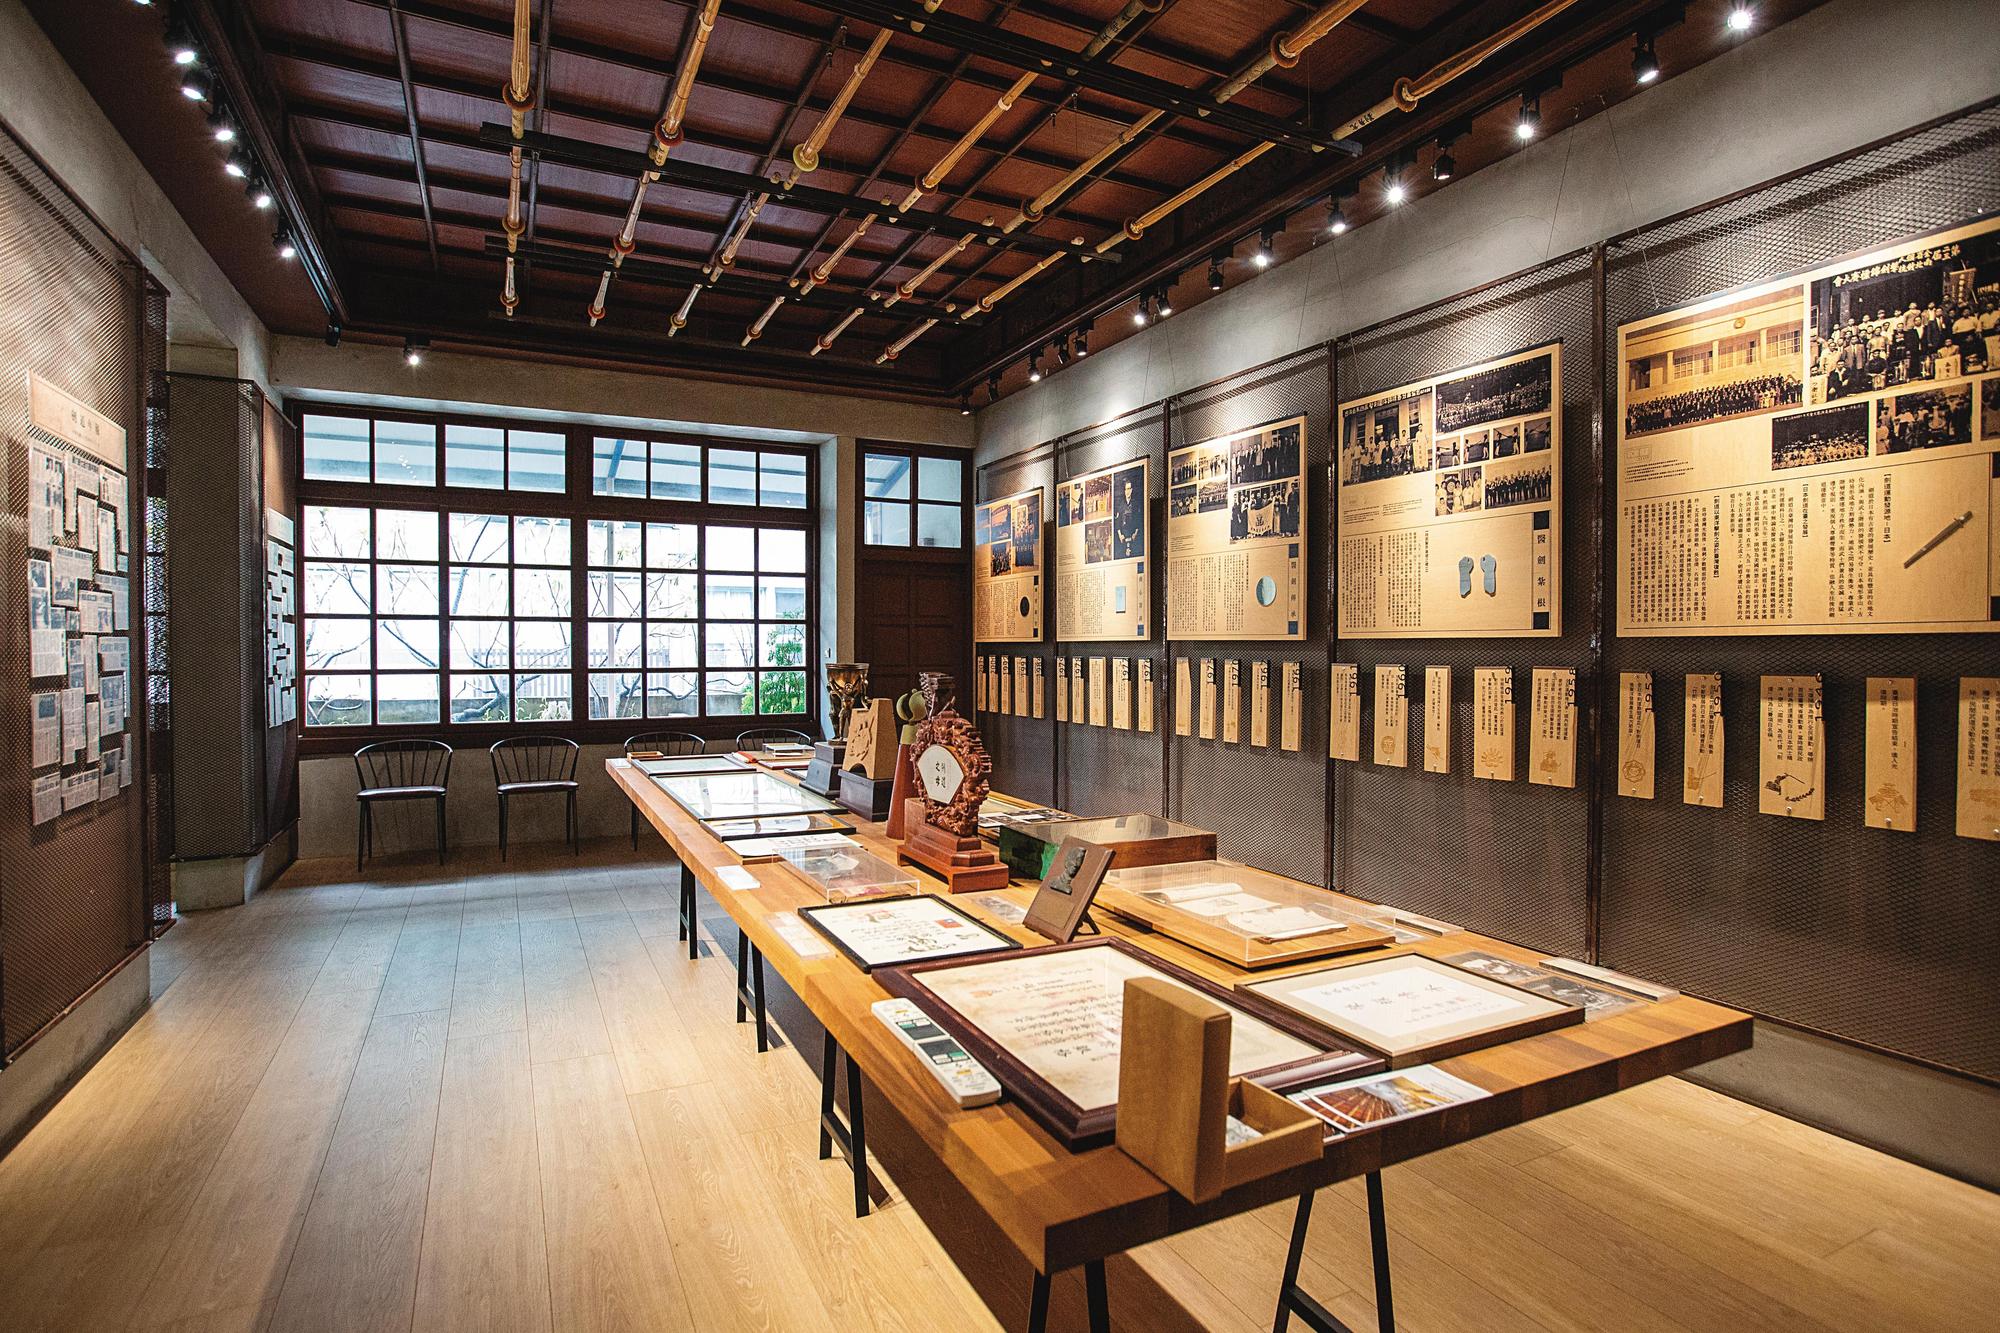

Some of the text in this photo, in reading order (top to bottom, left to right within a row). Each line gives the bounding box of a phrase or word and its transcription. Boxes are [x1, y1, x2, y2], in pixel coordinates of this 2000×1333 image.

[1350, 665, 1358, 696] 1961
[1398, 664, 1406, 698] 1960
[1505, 665, 1513, 704] 1959
[1568, 666, 1576, 706] 1958
[1714, 671, 1722, 717] 1950
[1815, 672, 1824, 722] 1946
